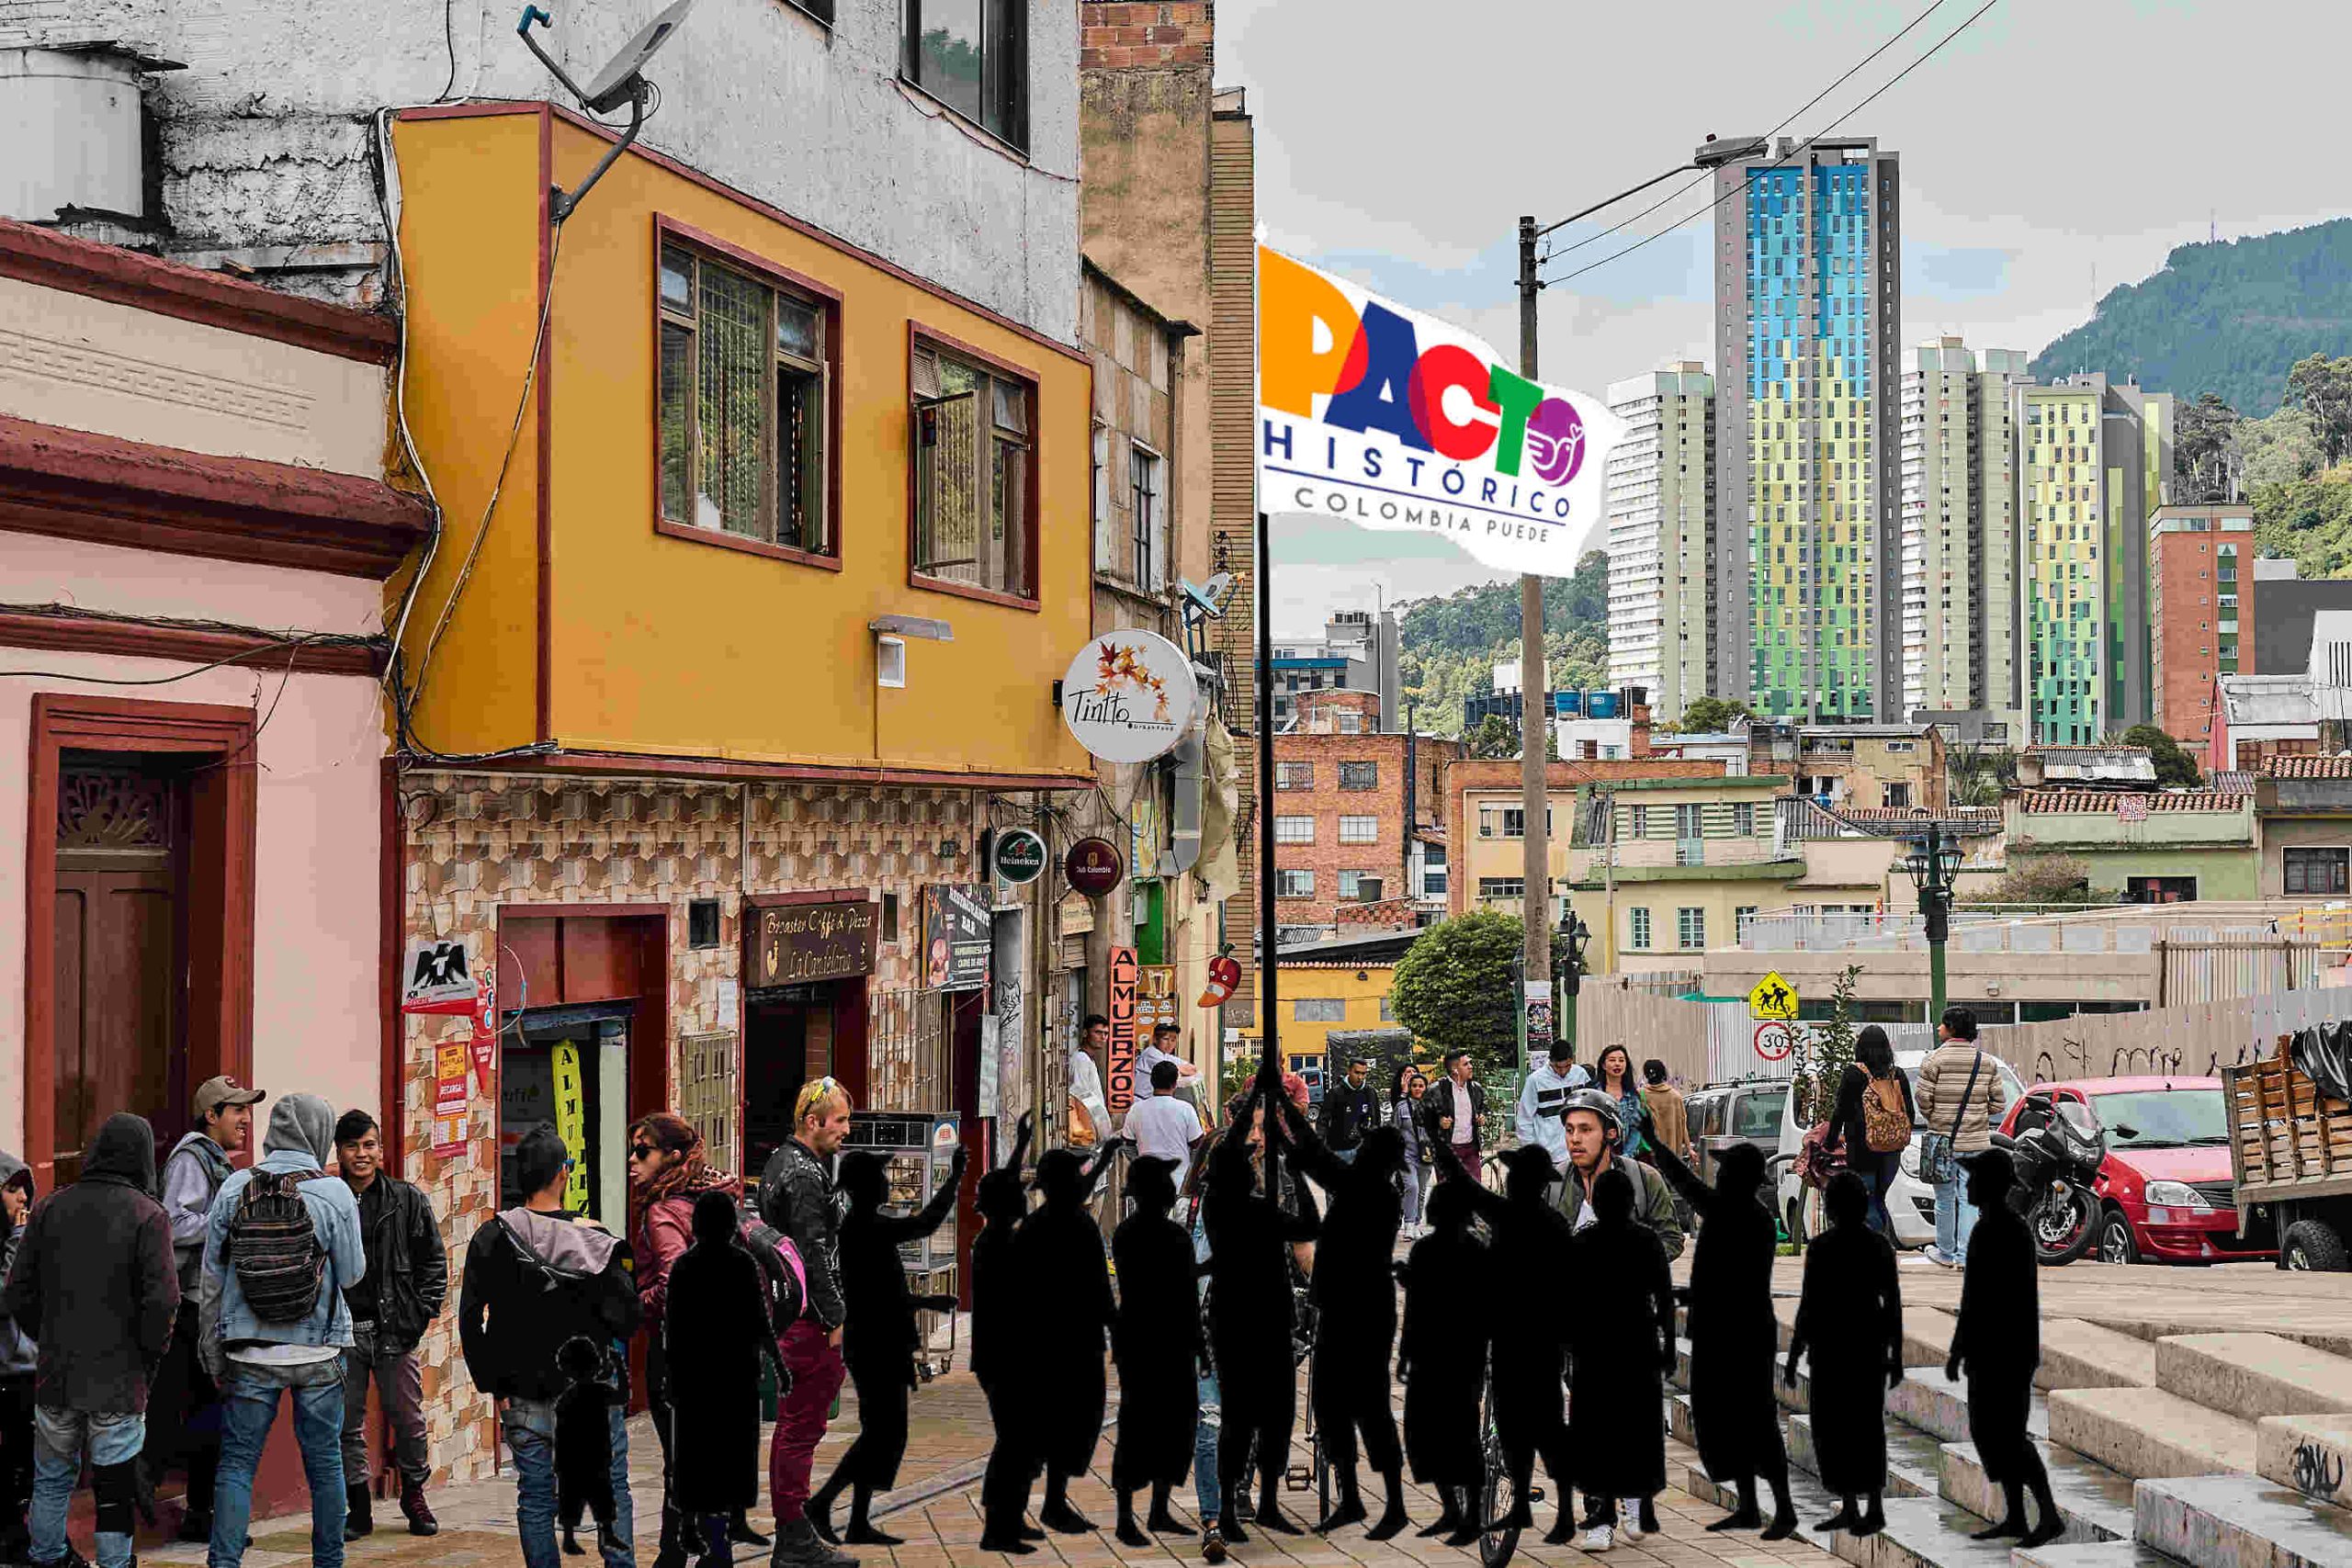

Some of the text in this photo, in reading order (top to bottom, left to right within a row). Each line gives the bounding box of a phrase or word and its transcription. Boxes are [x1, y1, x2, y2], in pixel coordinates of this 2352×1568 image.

[1263, 419, 1570, 518] HISTÓRICO
[1295, 488, 1549, 544] COLOMBIA PUEDE
[1000, 856, 1040, 865] Heineken
[1110, 950, 1136, 1110] ALMUERZOS
[1763, 1034, 1783, 1048] 30
